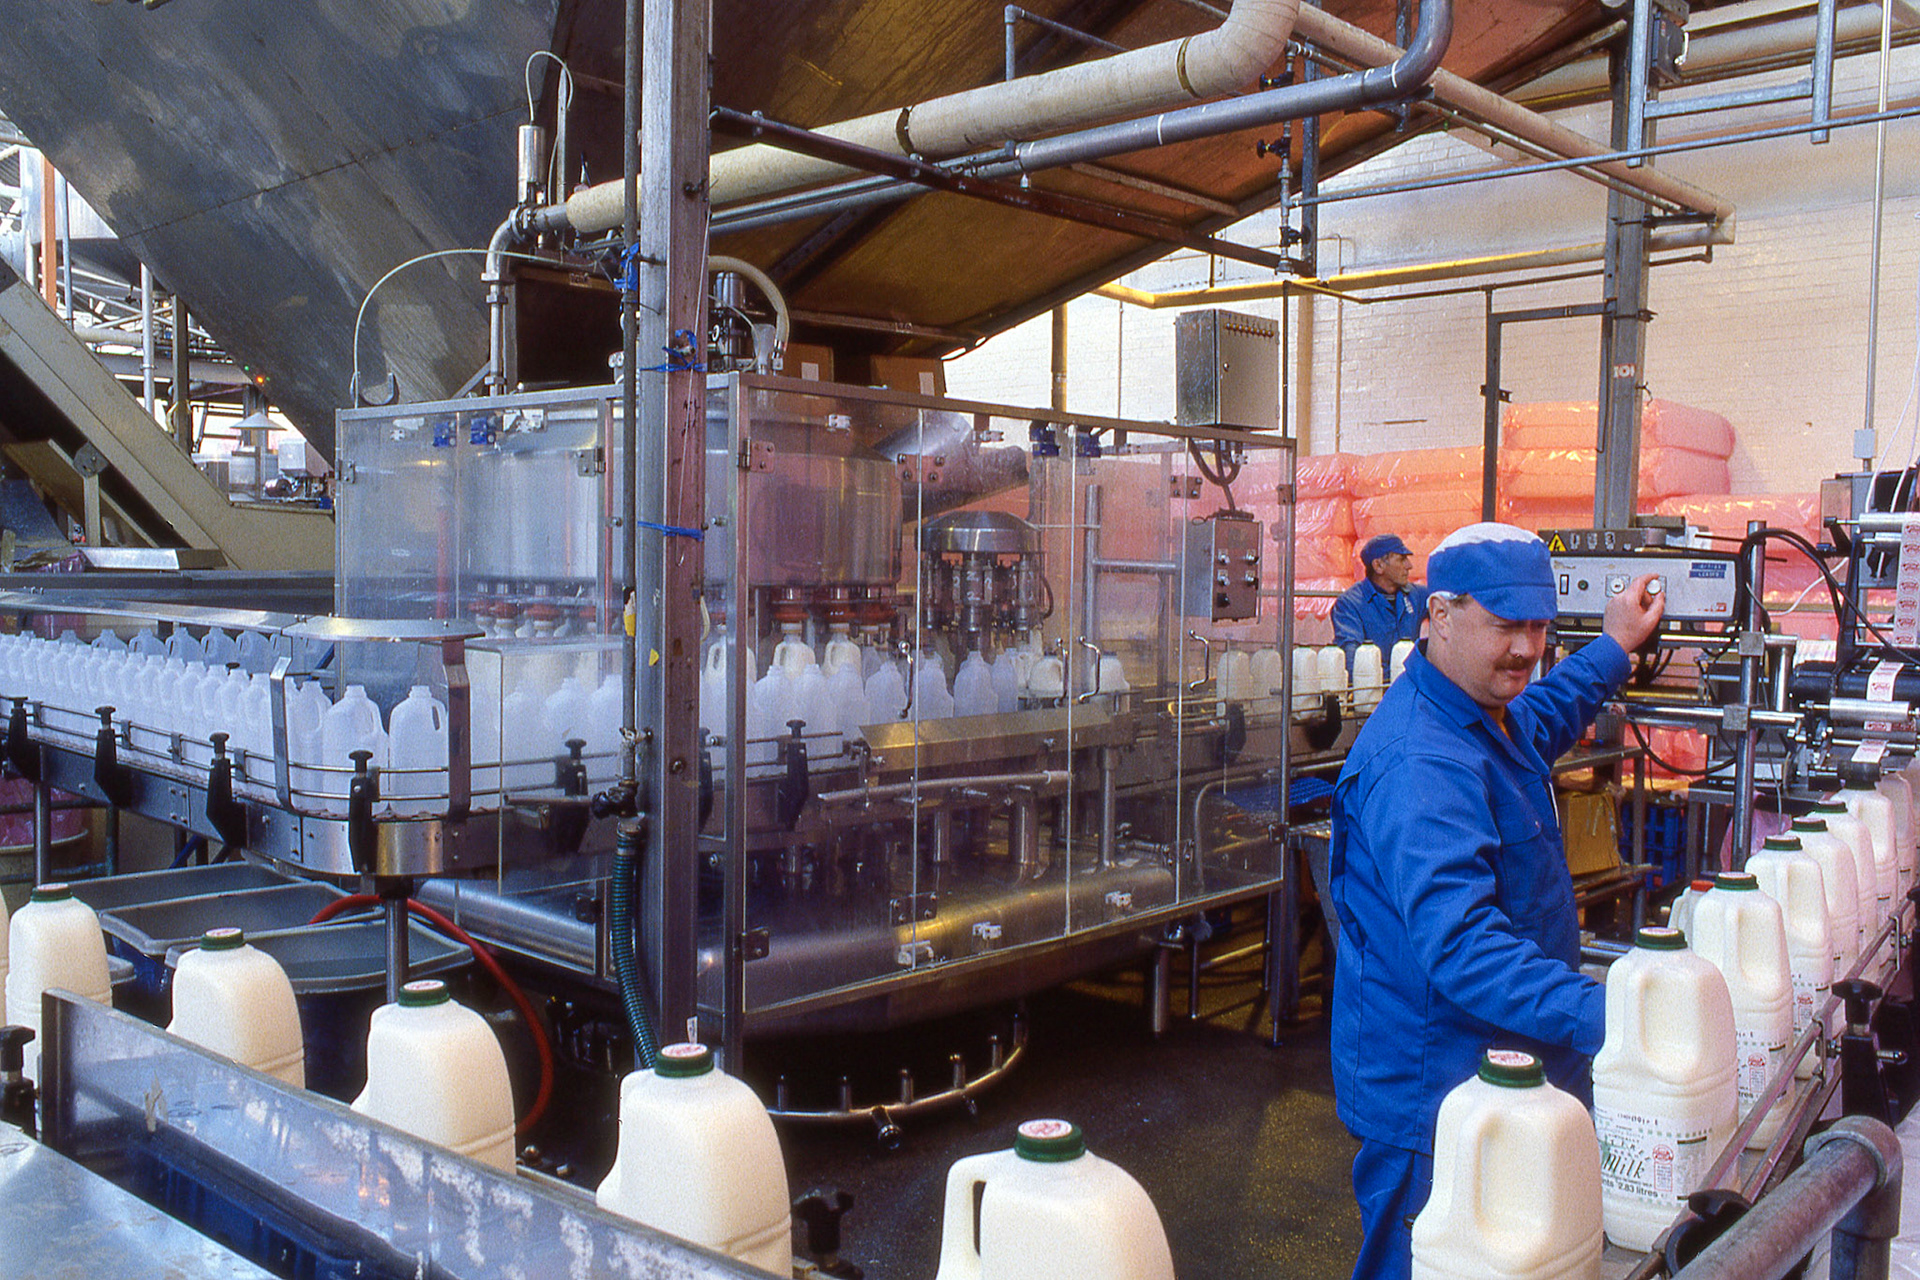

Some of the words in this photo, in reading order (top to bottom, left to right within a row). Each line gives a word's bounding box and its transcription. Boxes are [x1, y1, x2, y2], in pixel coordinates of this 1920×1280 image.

[1603, 1153, 1645, 1178] Milk
[1618, 1182, 1635, 1193] 2.83
[1636, 1185, 1659, 1198] litres
